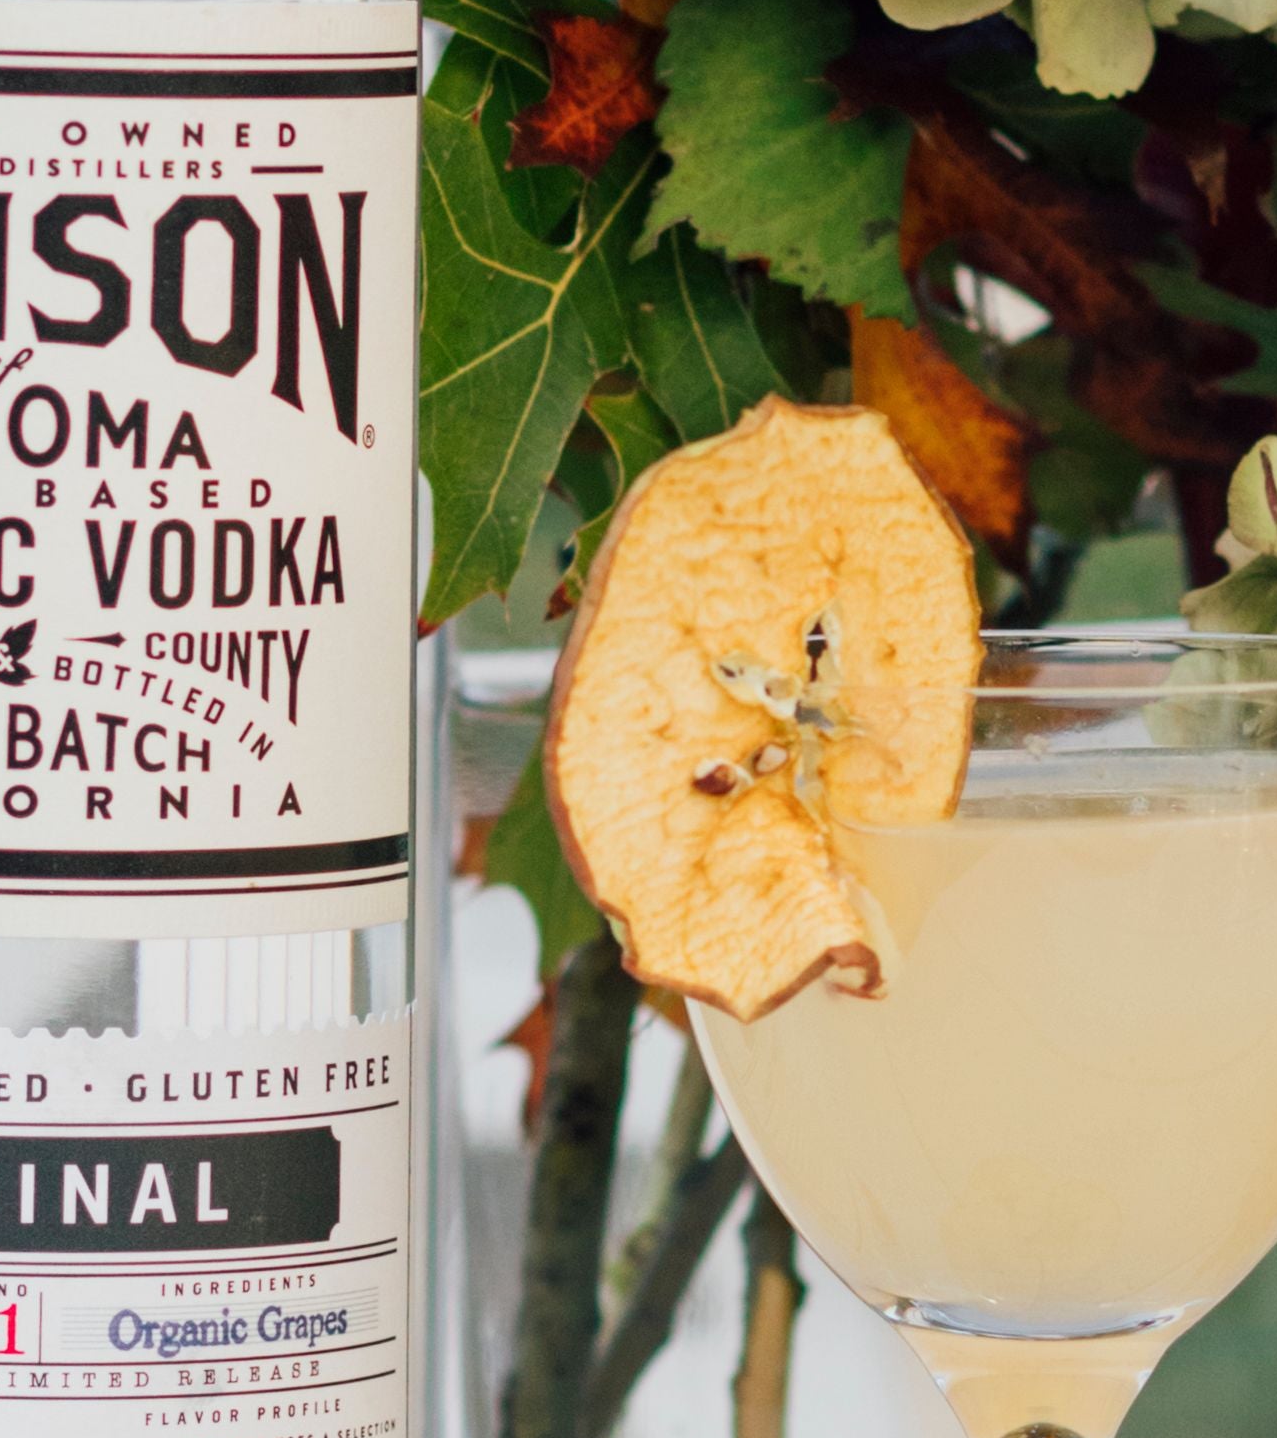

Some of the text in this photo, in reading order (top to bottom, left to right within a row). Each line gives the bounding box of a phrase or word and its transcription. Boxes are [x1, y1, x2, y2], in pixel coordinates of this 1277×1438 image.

[61, 121, 297, 148] OWNED
[35, 478, 272, 509] BASED
[84, 514, 345, 609] VODKA
[144, 628, 311, 726] COUNTY
[53, 655, 227, 725] BOTTLED
[238, 720, 275, 762] IN
[6, 703, 211, 773] BATCH
[126, 1066, 300, 1103] GLUTEN
[325, 1055, 390, 1093] FREE
[160, 1274, 317, 1297] INGREDIENTS
[108, 1305, 348, 1358] Organic Grapes
[178, 1360, 322, 1386] RELEASE
[145, 1398, 341, 1426] FLAVOR PROFILE
